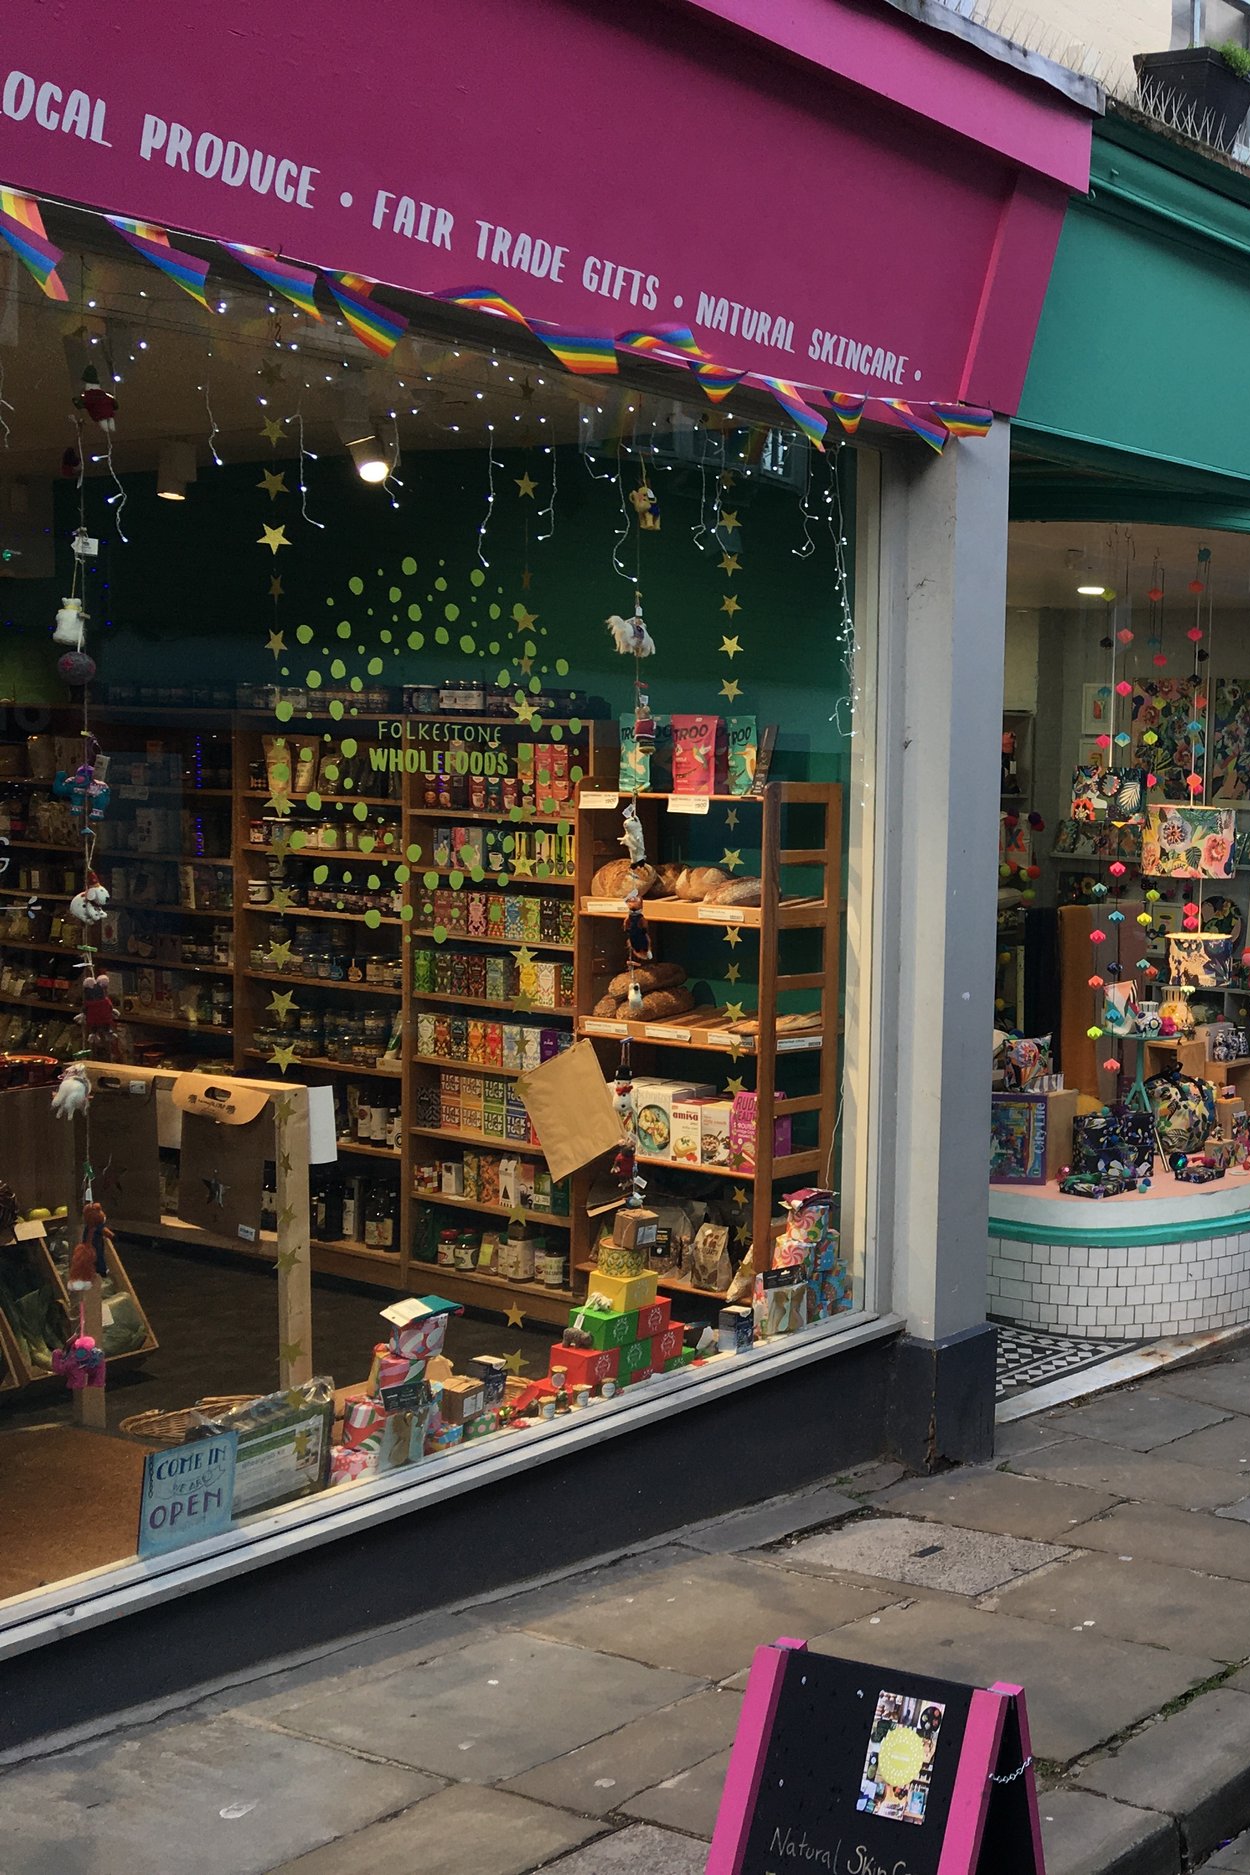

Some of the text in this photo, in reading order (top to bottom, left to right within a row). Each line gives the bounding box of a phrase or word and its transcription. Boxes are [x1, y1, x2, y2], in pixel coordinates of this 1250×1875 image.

[0, 70, 909, 386] OCAL PRODUCE FAIR TRADE GIFTS NATURAL SKINCARE
[378, 720, 501, 745] FOLKESTONE
[368, 748, 509, 776] WHOLEFOODS
[672, 1111, 699, 1122] amisa
[156, 1452, 204, 1481] COME
[208, 1445, 227, 1466] IN
[149, 1487, 222, 1530] OPEN
[769, 1826, 842, 1875] Natural
